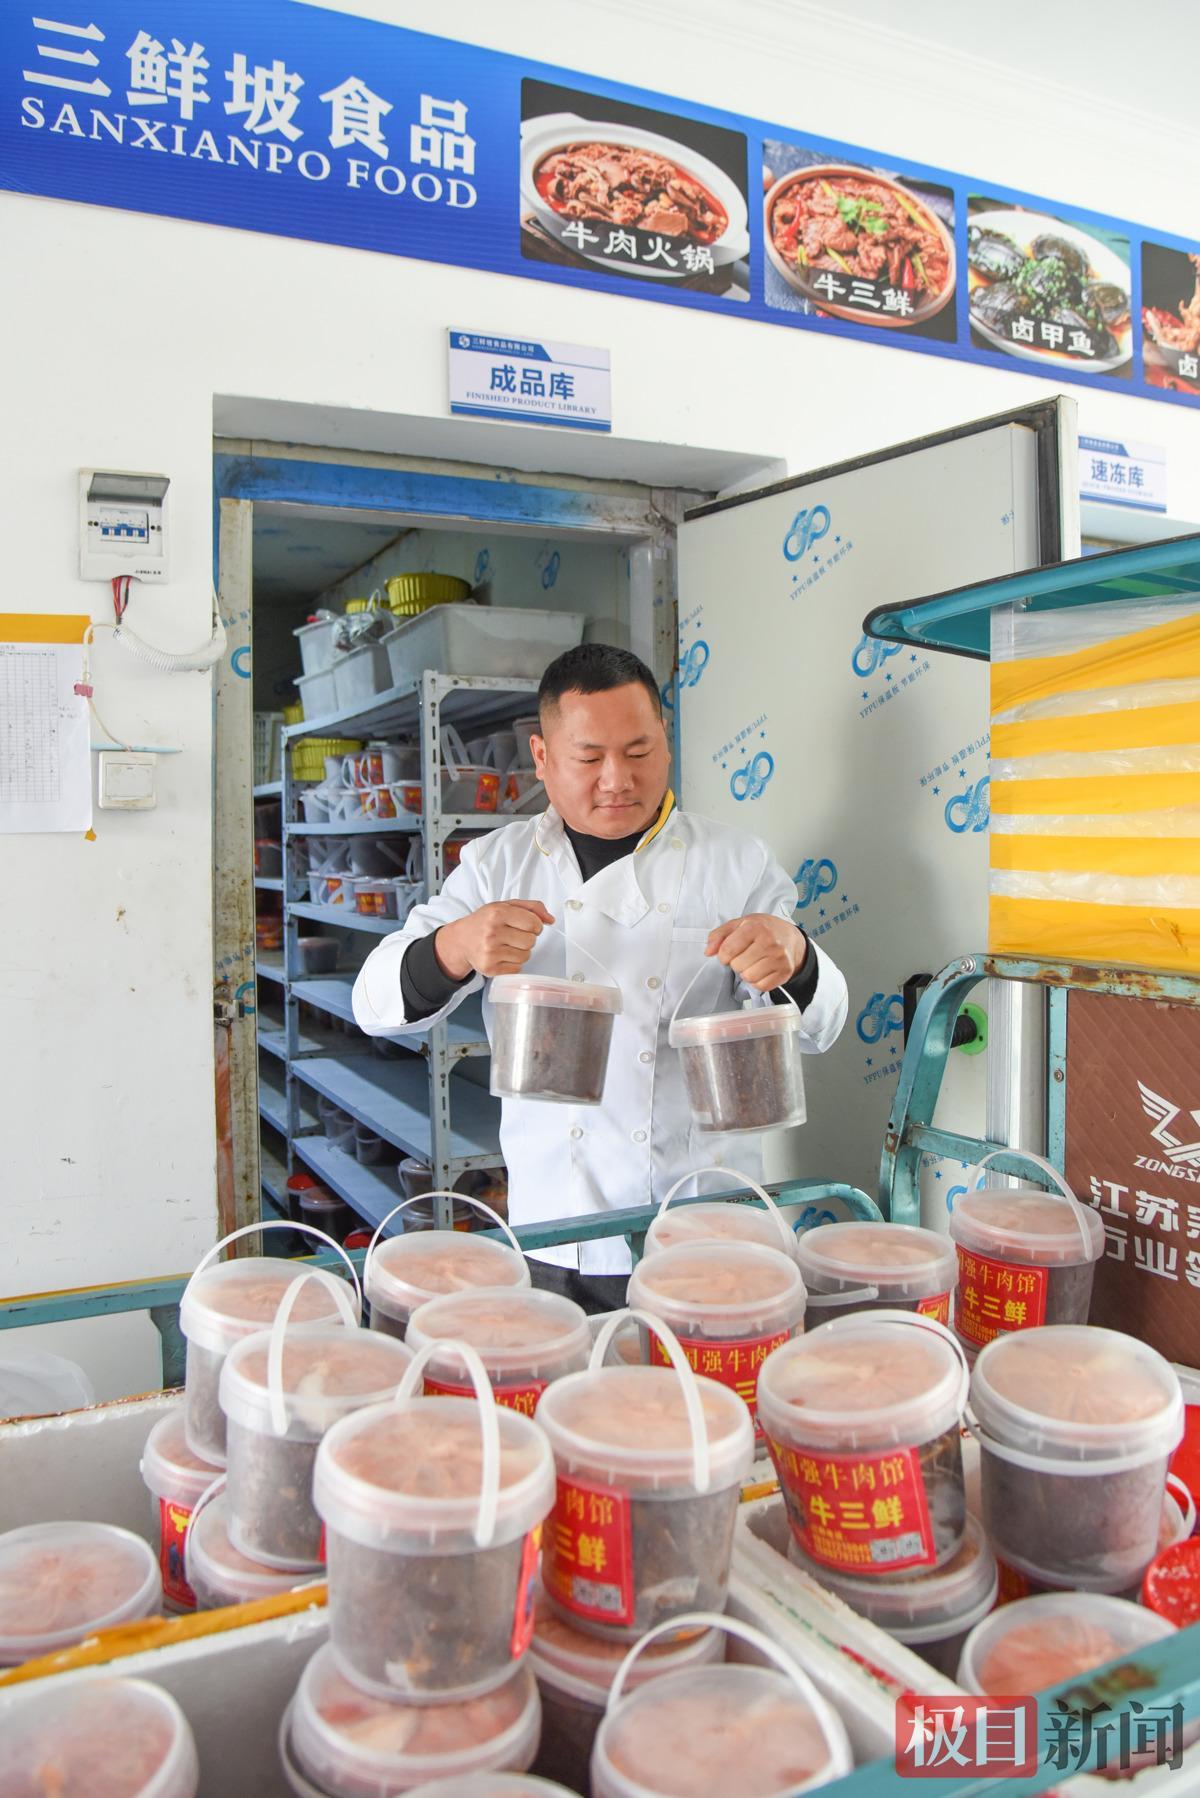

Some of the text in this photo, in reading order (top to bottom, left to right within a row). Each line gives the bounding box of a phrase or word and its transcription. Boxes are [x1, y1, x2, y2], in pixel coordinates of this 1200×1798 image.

[22, 17, 477, 175] 三鲜坡食品
[21, 97, 477, 209] SANXIANPO FOOD
[561, 219, 715, 276] 牛肉火锅
[812, 272, 914, 317] 牛三鲜
[1010, 316, 1096, 357] 卤甲鱼
[489, 364, 575, 401] 成品库
[1178, 354, 1198, 379] 卤
[466, 391, 597, 415] FINISHED PRODUCT LIBRARY
[1091, 459, 1144, 488] 速冻库
[964, 1286, 1027, 1325] 牛三鲜
[809, 1495, 905, 1530] 牛三鲜
